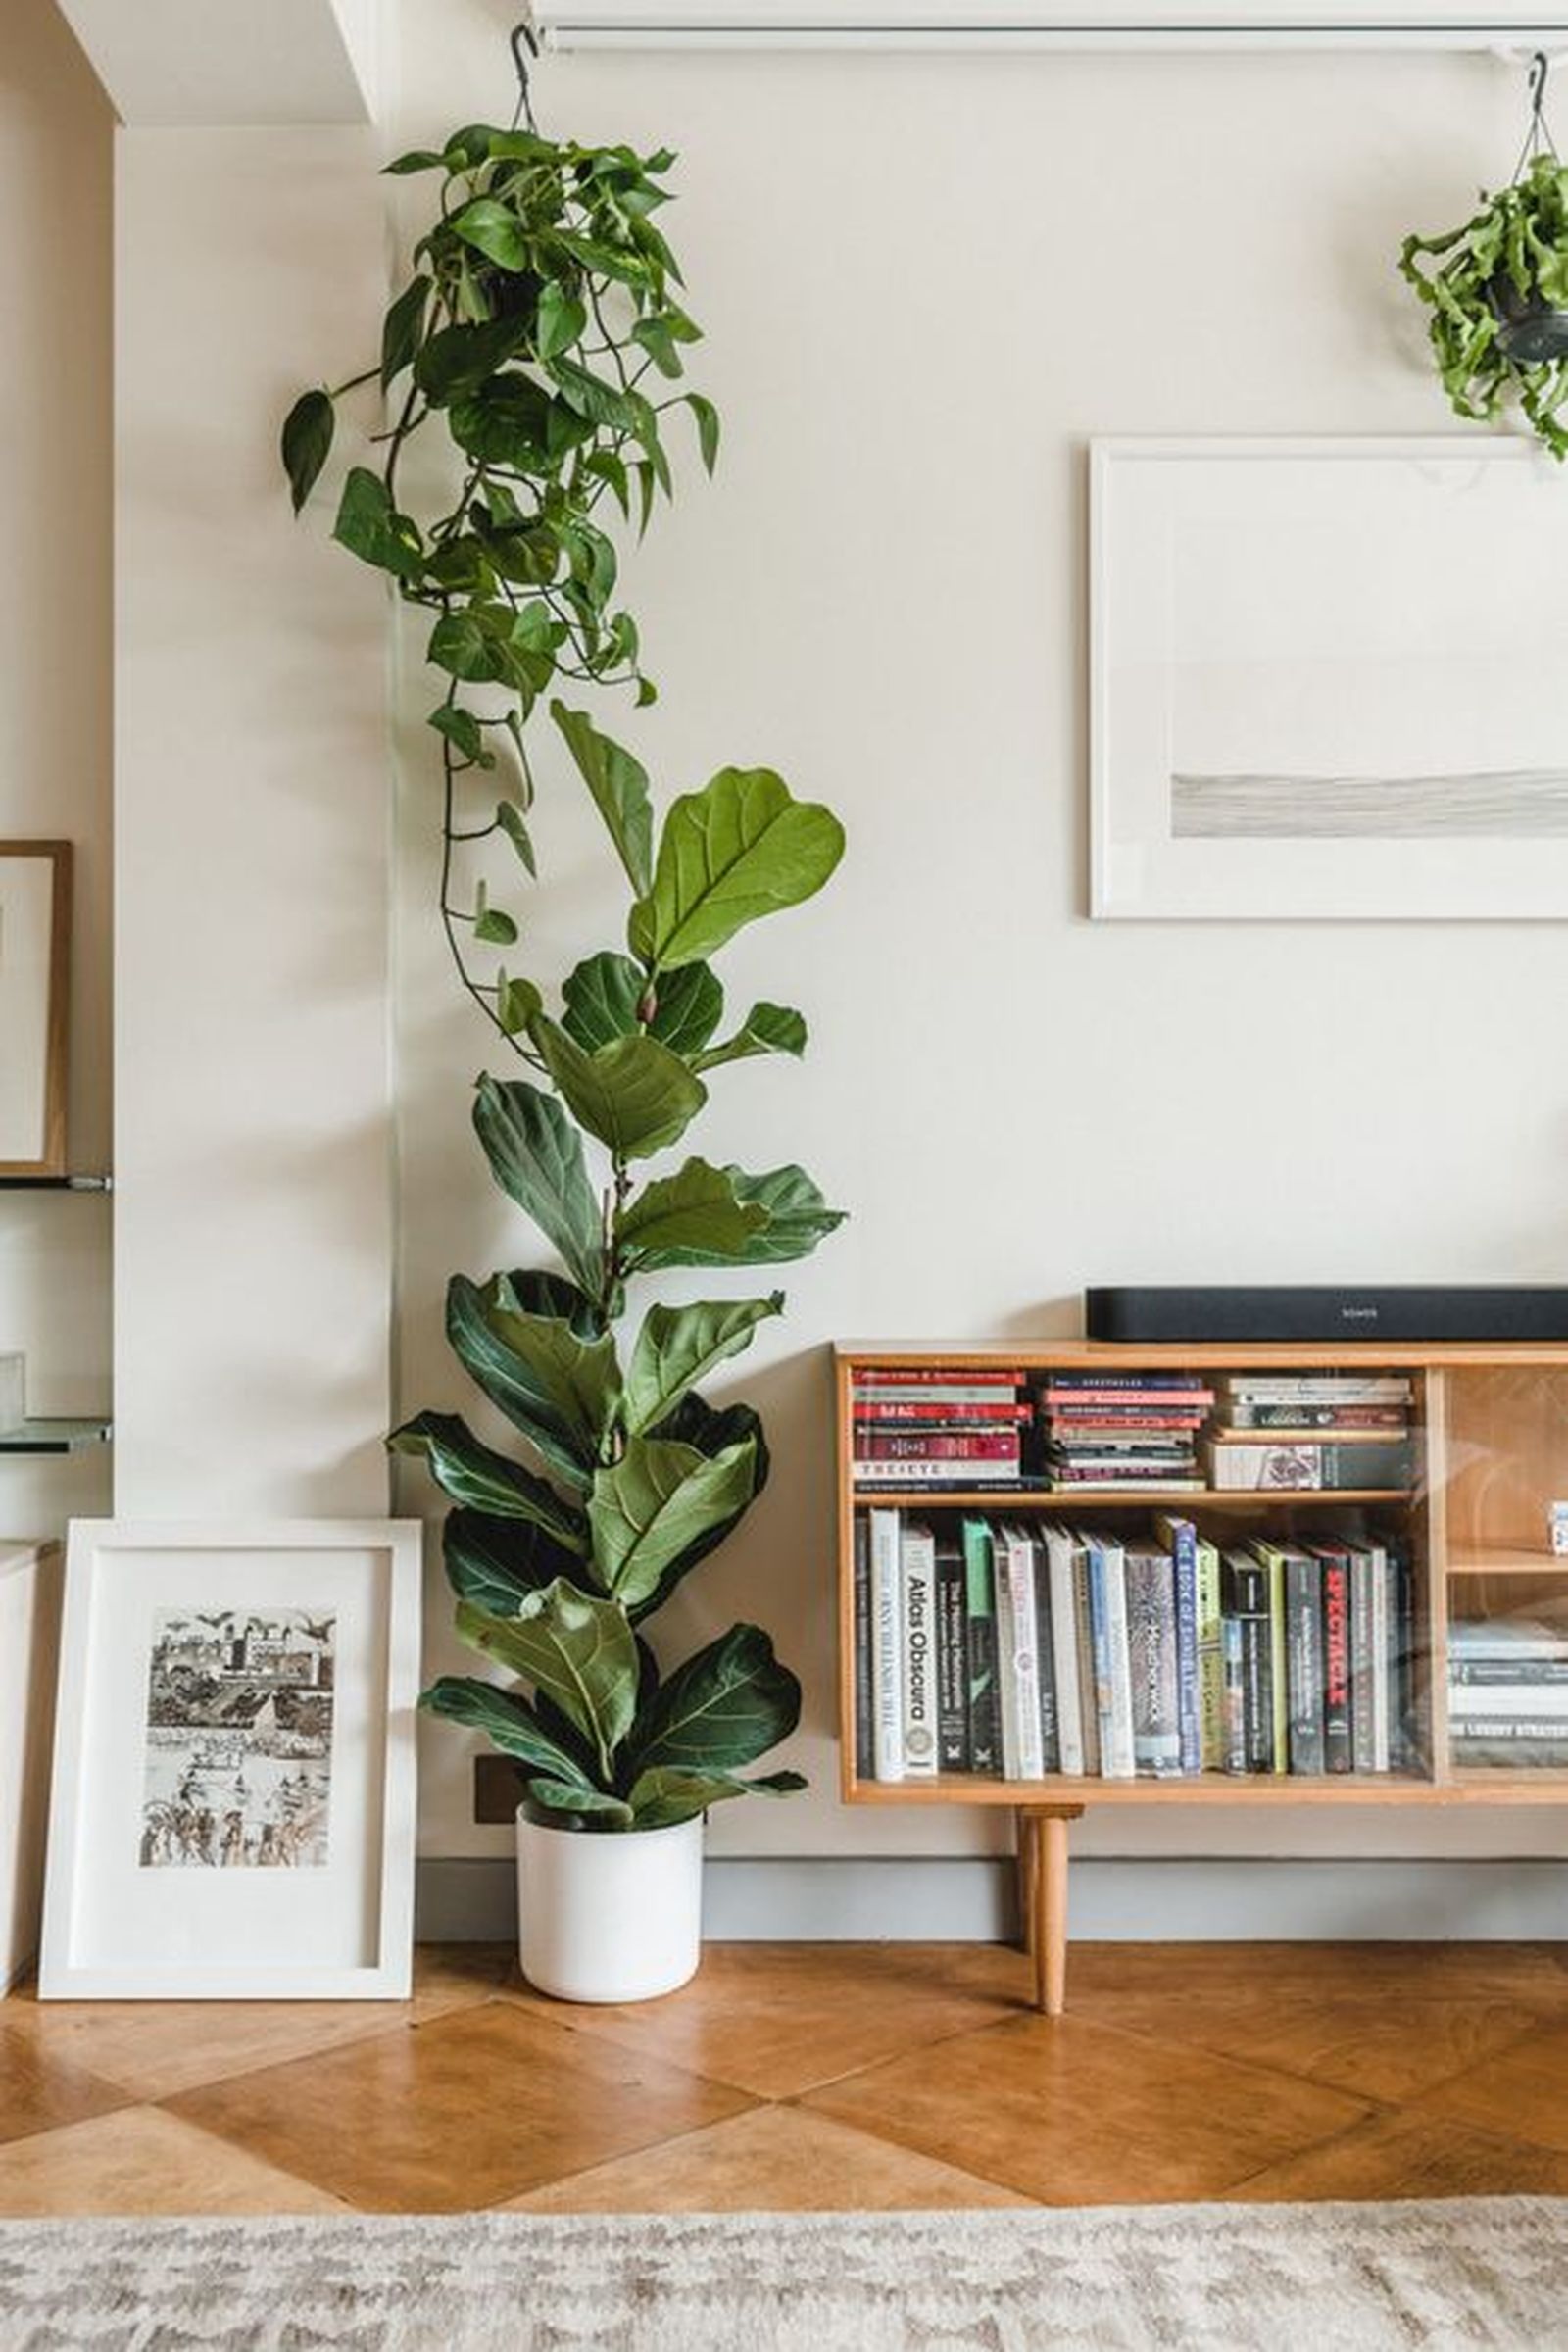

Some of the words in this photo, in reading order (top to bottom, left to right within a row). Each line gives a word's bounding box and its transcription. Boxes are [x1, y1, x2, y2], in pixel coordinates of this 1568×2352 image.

[907, 1576, 929, 1629] Atlas
[1179, 1563, 1193, 1599] BOOK
[1181, 1604, 1194, 1622] OF
[1326, 1568, 1348, 1705] SPECTACLE
[907, 1632, 930, 1720] Obscura
